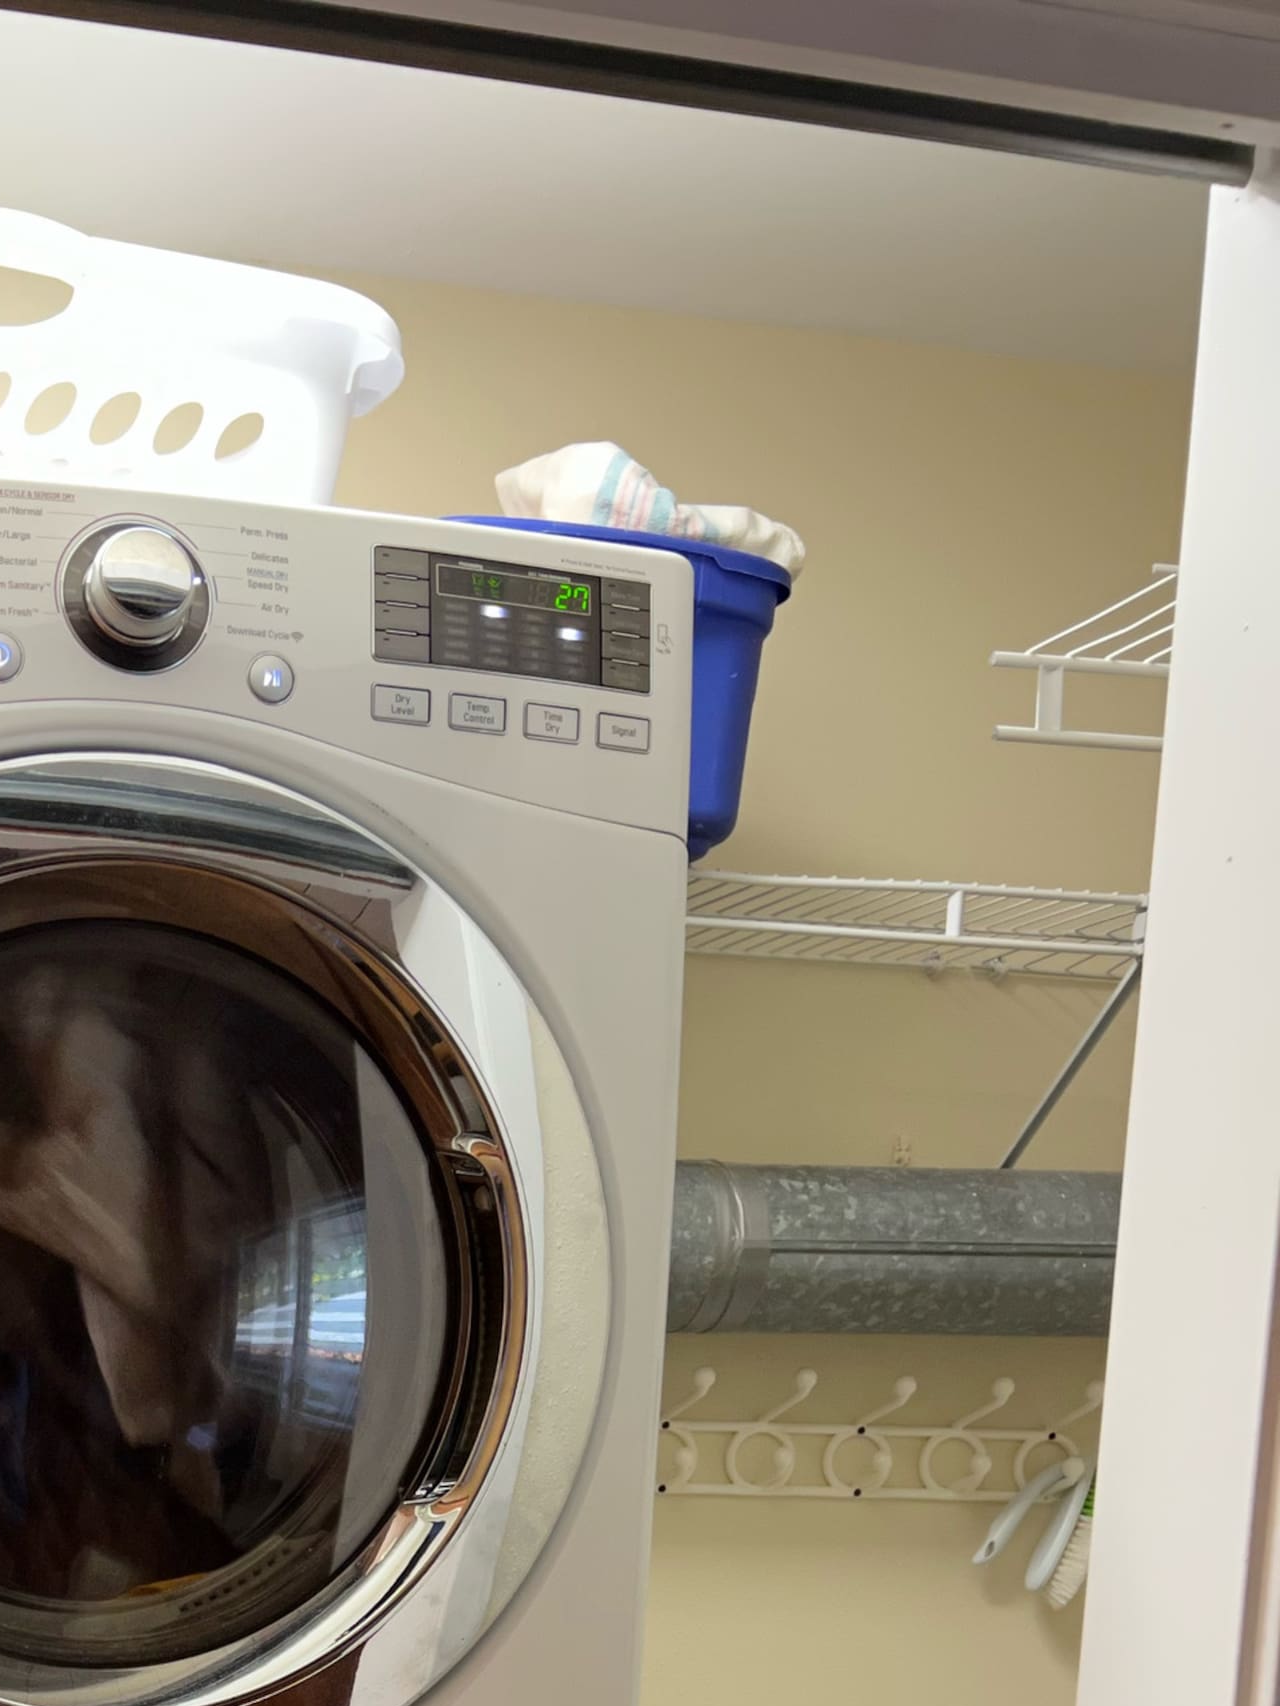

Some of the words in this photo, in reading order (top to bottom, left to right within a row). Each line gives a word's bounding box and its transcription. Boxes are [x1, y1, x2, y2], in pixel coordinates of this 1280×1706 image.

[266, 529, 288, 541] Press
[0, 556, 38, 567] Bacterial
[251, 551, 288, 565] Delicates
[247, 579, 273, 591] Speed
[274, 582, 288, 594] Dry
[554, 583, 589, 611] 27
[274, 604, 289, 616] Dry
[226, 625, 266, 639] Download
[268, 629, 290, 641] Cycle
[395, 693, 411, 706] Dry
[391, 704, 415, 717] Level
[543, 710, 563, 723] Time
[463, 712, 495, 725] Control
[545, 722, 561, 735] Dry
[611, 724, 637, 739] Signal
